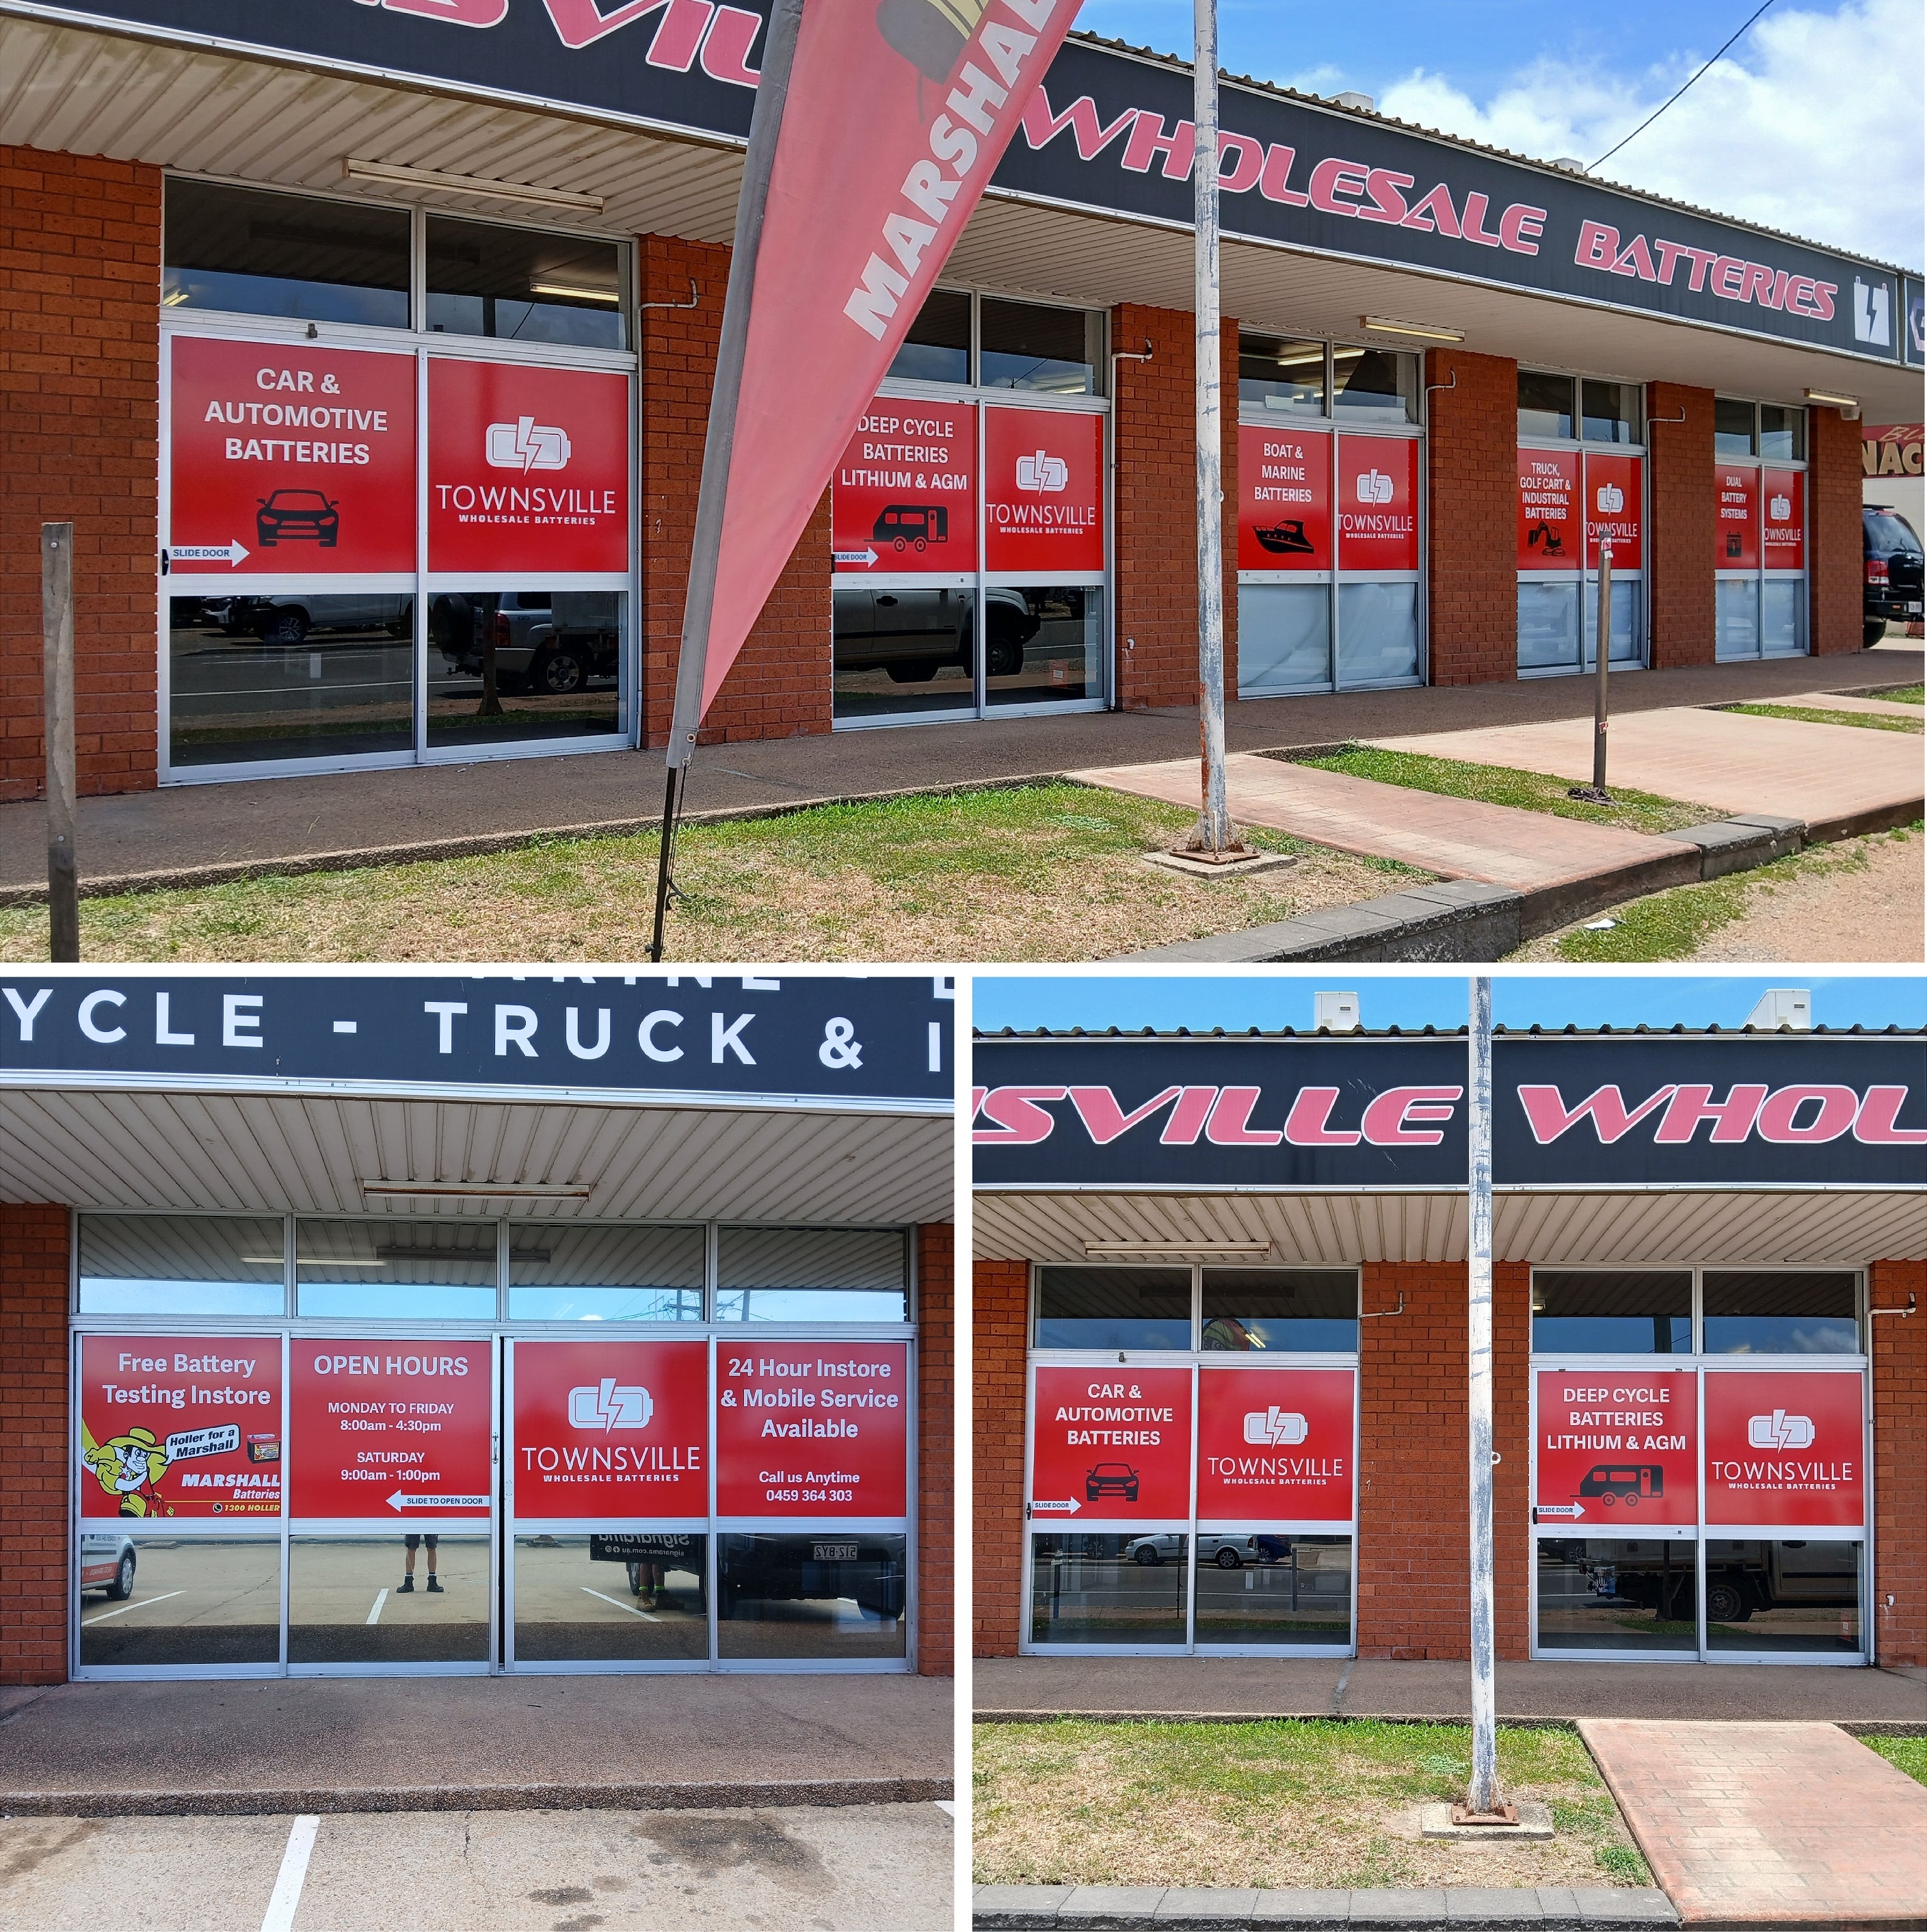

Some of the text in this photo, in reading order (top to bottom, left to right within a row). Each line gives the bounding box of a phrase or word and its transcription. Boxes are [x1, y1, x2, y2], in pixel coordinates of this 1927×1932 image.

[1019, 83, 1838, 321] WHOLESALE BATTERIES
[256, 368, 341, 395] CAR &
[204, 401, 388, 432] AUTOMOTIVE
[857, 416, 954, 438] DEEP CYCLE
[226, 438, 370, 464] BATTERIES
[863, 442, 948, 464] BATTERIES
[1264, 442, 1303, 459] BOAT &
[1861, 440, 1924, 475] NAC
[1262, 464, 1305, 481] MARINE
[1530, 462, 1560, 477] TRUCK,
[842, 468, 967, 490] LITHIUM & AGM
[1519, 476, 1571, 490] GOLF CART &
[1726, 475, 1742, 488] DUAL
[436, 484, 617, 515] TOWNSVILLE
[1254, 486, 1312, 503] BATTERIES
[1522, 491, 1569, 505] INDUSTRIAL
[1721, 492, 1747, 504] BATTERY
[458, 514, 596, 525] WHOLESALE BATTERIES
[987, 503, 1095, 525] TOWNSVILLE
[1525, 507, 1567, 520] BATTERIES
[1720, 507, 1748, 520] SYSTEMS
[1338, 514, 1413, 531] TOWNSVILLE
[1586, 521, 1638, 538] OWNSVILLE
[1764, 527, 1801, 541] OWNSVILLE
[202, 549, 230, 557] DOOR
[423, 1001, 758, 1066] TRUCK
[818, 1016, 864, 1070] &
[119, 1353, 256, 1378] Free Battery
[314, 1355, 468, 1376] OPEN HOURS
[728, 1358, 891, 1377] 24 Hour Instore
[102, 1384, 271, 1409] Testing Instore
[721, 1388, 899, 1408] & Mobile Service
[1087, 1384, 1142, 1399] CAR &
[1563, 1388, 1670, 1403] DEEP CYCLE
[328, 1402, 455, 1414] MONDAY TO FRIDAY
[1055, 1407, 1173, 1422] AUTOMOTIVE
[340, 1419, 386, 1431] 8:00am
[395, 1420, 441, 1433] 4:30pm
[760, 1418, 858, 1438] Available
[1569, 1412, 1664, 1427] BATTERIES
[168, 1428, 236, 1447] Holler for a
[1067, 1430, 1160, 1446] BATTERIES
[1547, 1435, 1686, 1450] LITHIUM & AGM
[175, 1438, 234, 1459] Marshall
[357, 1451, 425, 1463] SATURDAY
[521, 1446, 700, 1471] TOWNSVILLE
[1207, 1457, 1343, 1477] TOWNSVILLE
[341, 1469, 387, 1481] 9:00am
[396, 1469, 440, 1483] 1:00pm
[616, 1474, 679, 1482] BATTERIES
[759, 1470, 860, 1486] Call us Anytime
[1711, 1461, 1853, 1481] TOWNSVILLE
[181, 1474, 280, 1487] MARSHALL
[232, 1488, 280, 1499] Batteries
[766, 1490, 853, 1502] 0459 364 303
[224, 1504, 280, 1512] 1300 HOLLER
